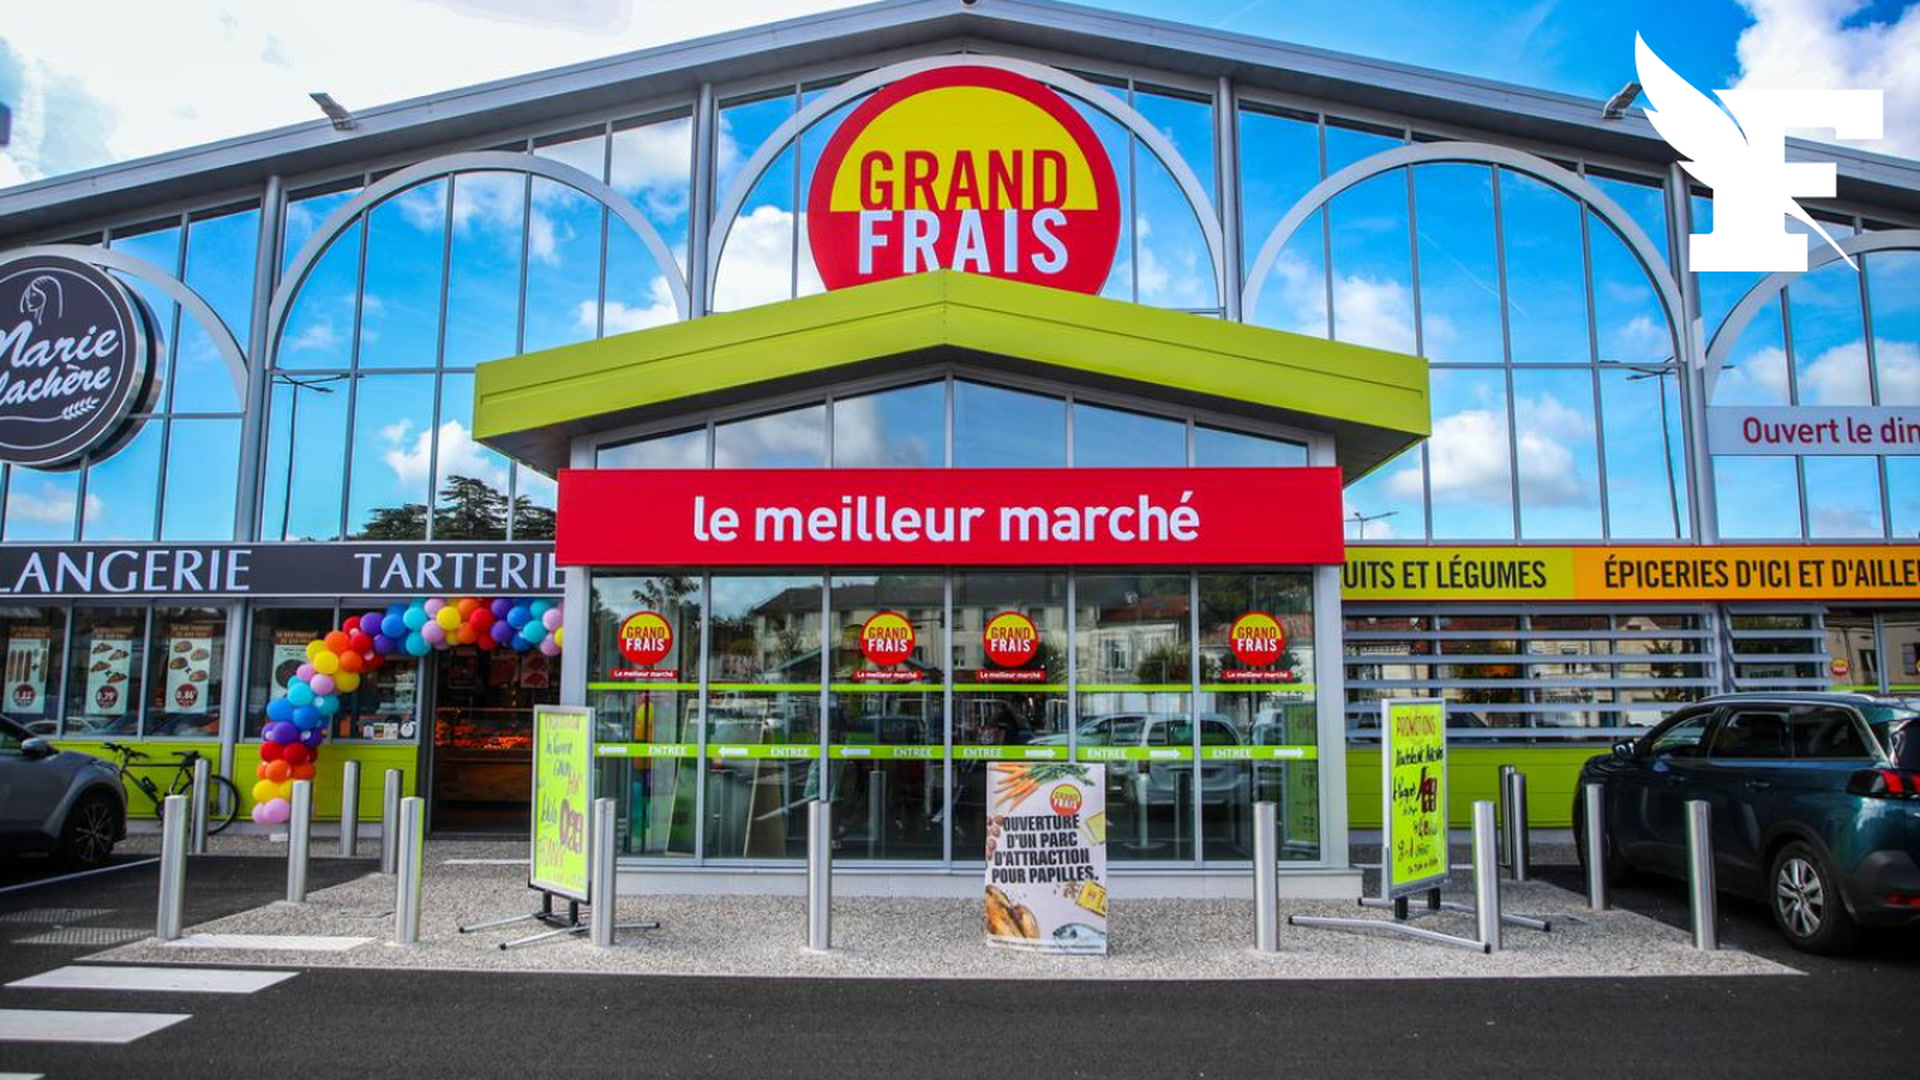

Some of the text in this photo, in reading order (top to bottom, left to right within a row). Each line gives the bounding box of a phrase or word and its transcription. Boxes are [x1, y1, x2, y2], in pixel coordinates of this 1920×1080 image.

[860, 150, 1067, 210] GRAND
[859, 208, 1068, 274] FRAIS
[1743, 416, 1840, 444] Ouvert
[1847, 417, 1872, 443] le
[694, 490, 1200, 541] le meilleur marché
[0, 550, 252, 593] ANGERIE
[1344, 560, 1395, 589] UITS
[1403, 560, 1429, 589] ET
[1436, 554, 1546, 589] LÉGUMES
[1604, 554, 1729, 588] ÉPICERIES
[1736, 560, 1791, 588] D'ICI
[1798, 560, 1824, 588] ET
[627, 627, 665, 638] GRAND
[868, 627, 908, 639] GRAND
[991, 627, 1030, 639] GRAND
[1237, 626, 1276, 638] GRAND
[626, 638, 665, 651] FRAIS
[868, 638, 908, 652] FRAIS
[991, 638, 1031, 652] FRAIS
[1237, 638, 1277, 652] FRAIS
[1003, 814, 1080, 831] OUVERTURE
[1006, 832, 1077, 849] D'UN PARC
[994, 848, 1090, 866] D'ATTRACTION
[992, 866, 1099, 884] POUR PAPILLES.
